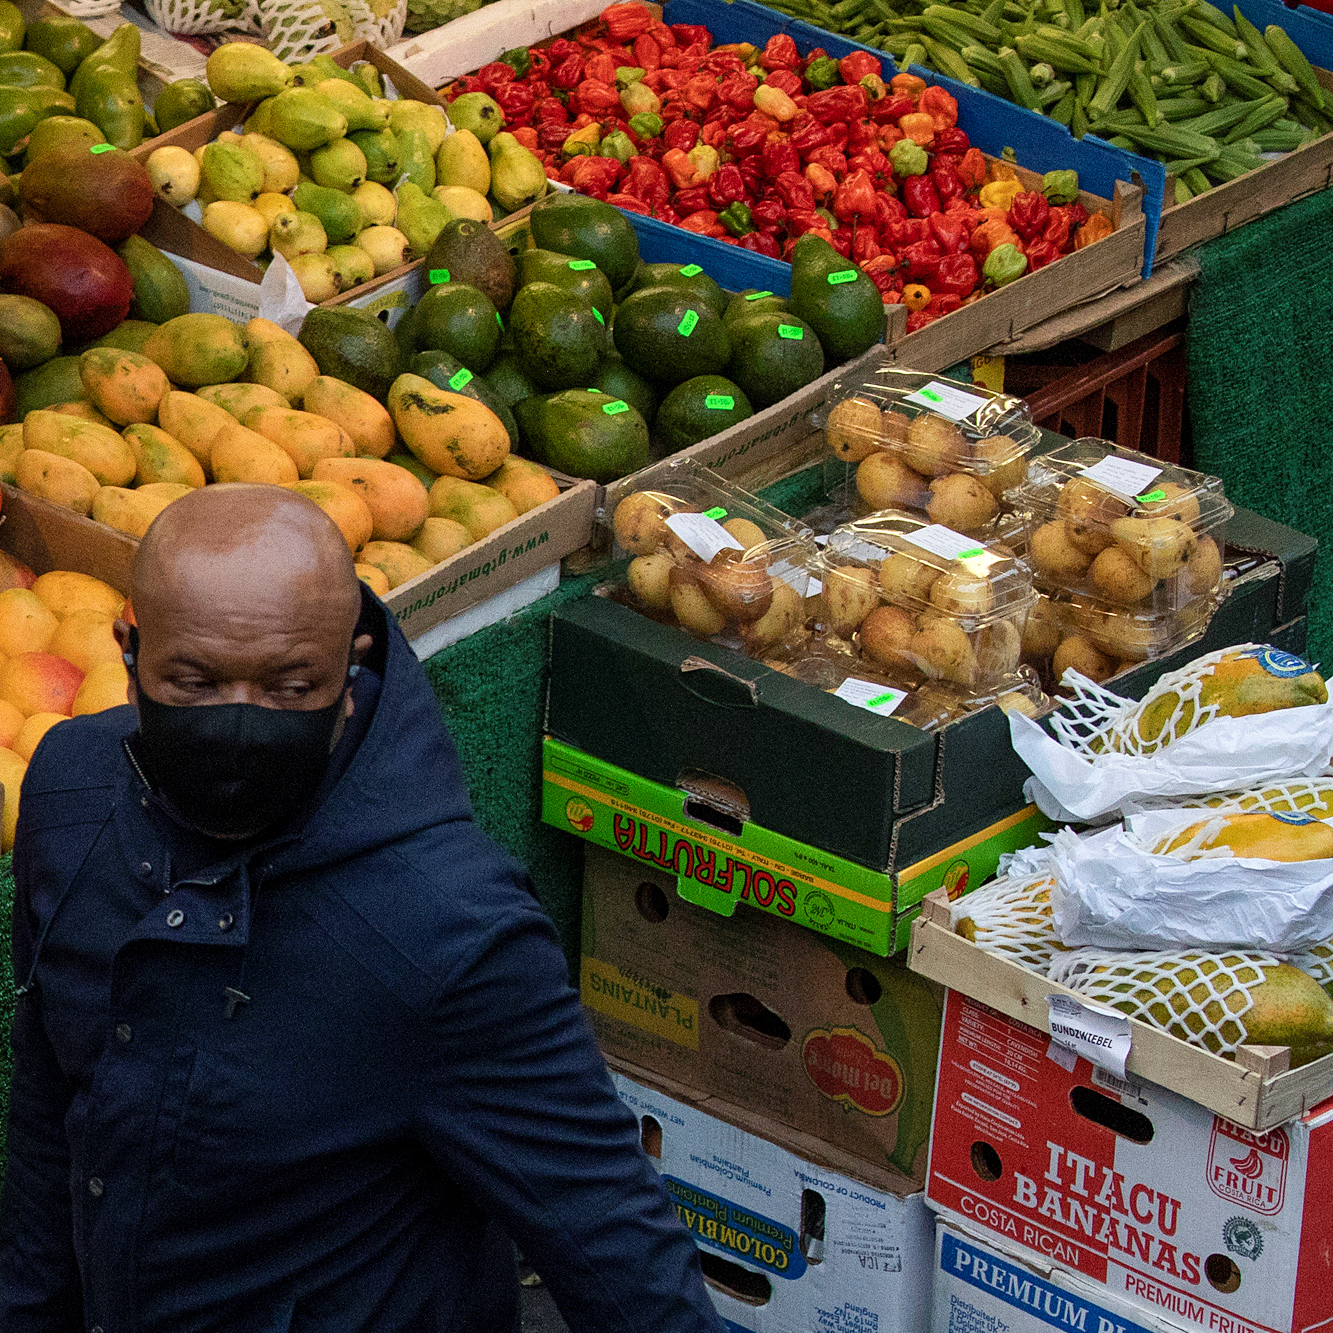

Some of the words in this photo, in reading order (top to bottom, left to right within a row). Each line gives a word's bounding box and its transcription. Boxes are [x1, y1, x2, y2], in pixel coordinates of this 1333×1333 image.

[613, 813, 798, 917] SOLFRUTTA
[749, 855, 770, 870] ITALY
[590, 972, 694, 1031] PLANTAINS
[961, 1017, 987, 1033] VARIETY:
[1006, 1037, 1039, 1059] CAVENDISH
[1008, 1016, 1030, 1034] COSTA
[1051, 1021, 1113, 1050] BUNDZWIEBEL
[862, 1068, 893, 1100] Del
[639, 1099, 669, 1119] WEIGHT
[669, 1112, 685, 1126] NET
[689, 1152, 735, 1179] Colombian
[713, 1154, 750, 1178] Plantains
[735, 1171, 772, 1197] Premium
[793, 1169, 835, 1191] COLOMBIA
[834, 1184, 848, 1196] OF
[1042, 1140, 1182, 1237] ITACU
[1213, 1164, 1278, 1205] FRUIT
[665, 1179, 730, 1222] Plantains
[848, 1188, 886, 1210] PRODUCT
[1218, 1183, 1245, 1206] COSTA
[1245, 1192, 1268, 1209] RICA
[732, 1206, 794, 1251] Premium
[960, 1196, 1018, 1239] COSTA
[1022, 1220, 1081, 1267] RICAN
[1012, 1170, 1201, 1286] BANANAS
[858, 1254, 879, 1271] ICA
[953, 1246, 1088, 1333] PREMIUM
[1124, 1272, 1206, 1326] PREMIUM
[844, 1303, 879, 1322] England
[949, 1304, 986, 1330] Tropifruit
[951, 1294, 995, 1324] Distribuited
[817, 1316, 836, 1331] way
